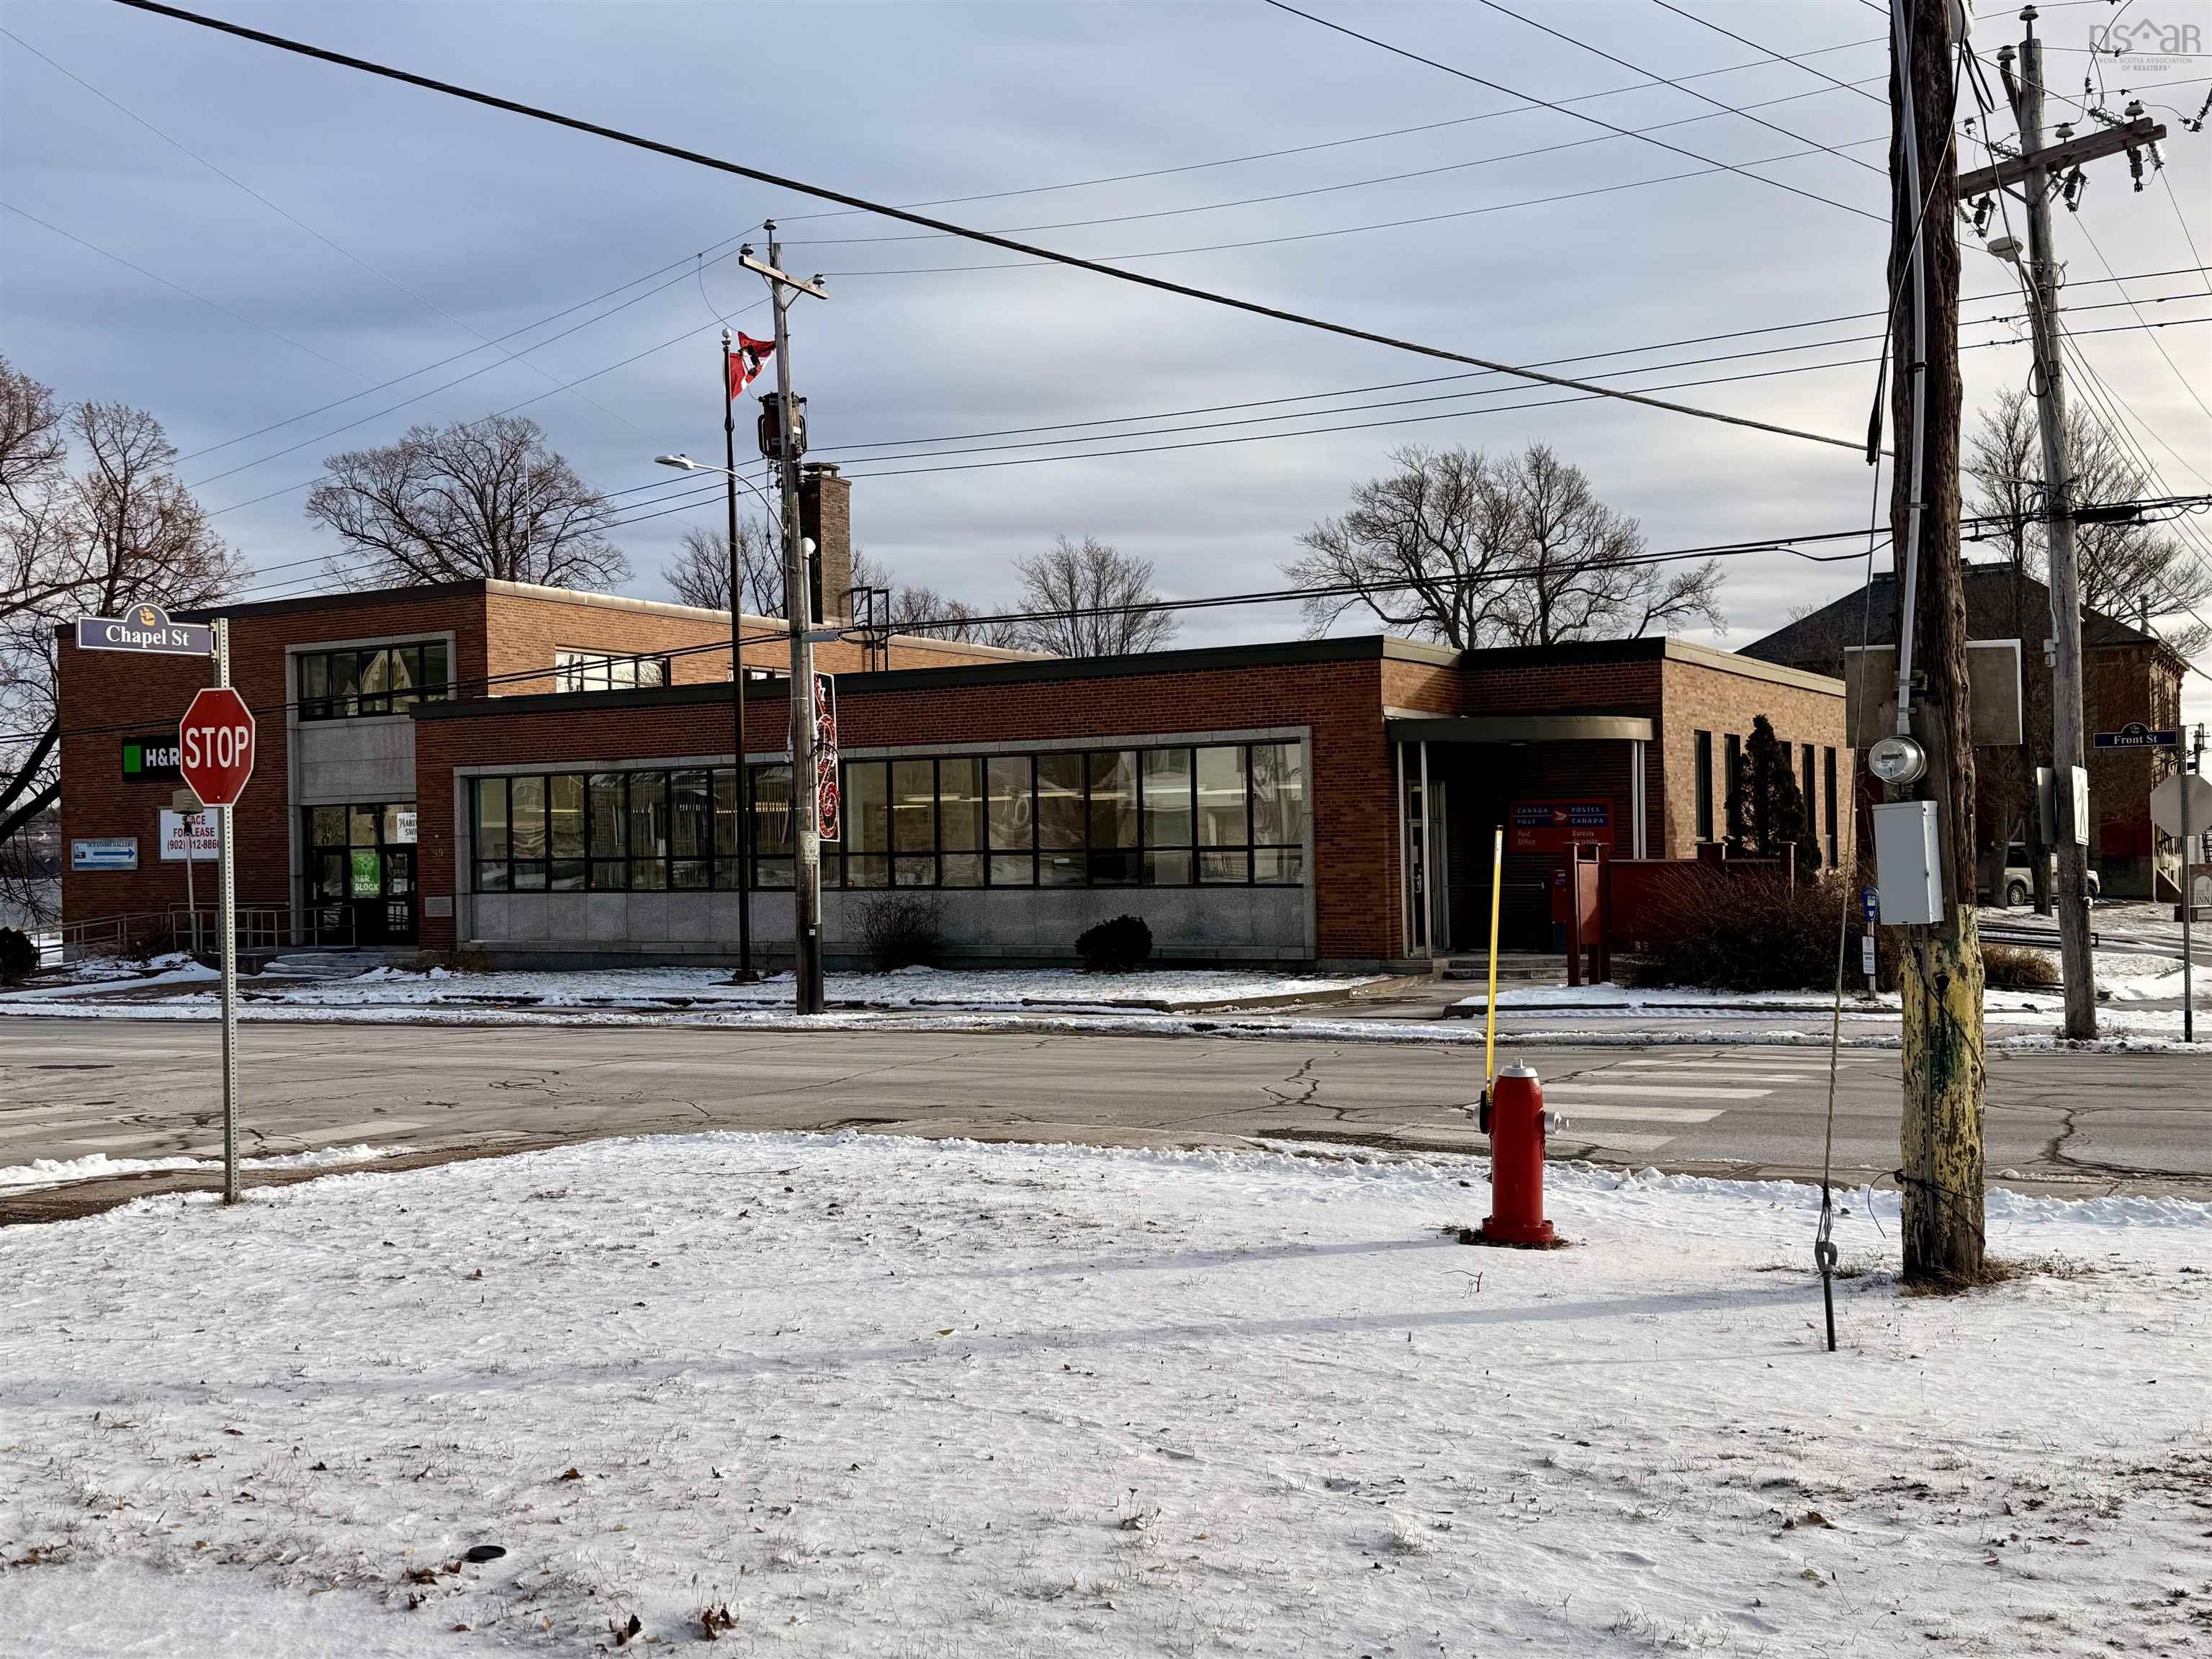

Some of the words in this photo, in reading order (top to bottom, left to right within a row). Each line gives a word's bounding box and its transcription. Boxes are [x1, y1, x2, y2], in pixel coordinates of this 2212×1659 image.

[106, 625, 166, 648] Chapel
[171, 629, 189, 646] St
[2113, 735, 2144, 745] Front
[2146, 734, 2158, 743] St
[186, 726, 249, 768] STOP
[145, 747, 180, 767] H&R
[167, 840, 186, 851] (902)
[1517, 837, 1537, 846] Office
[354, 883, 379, 891] BLOCK
